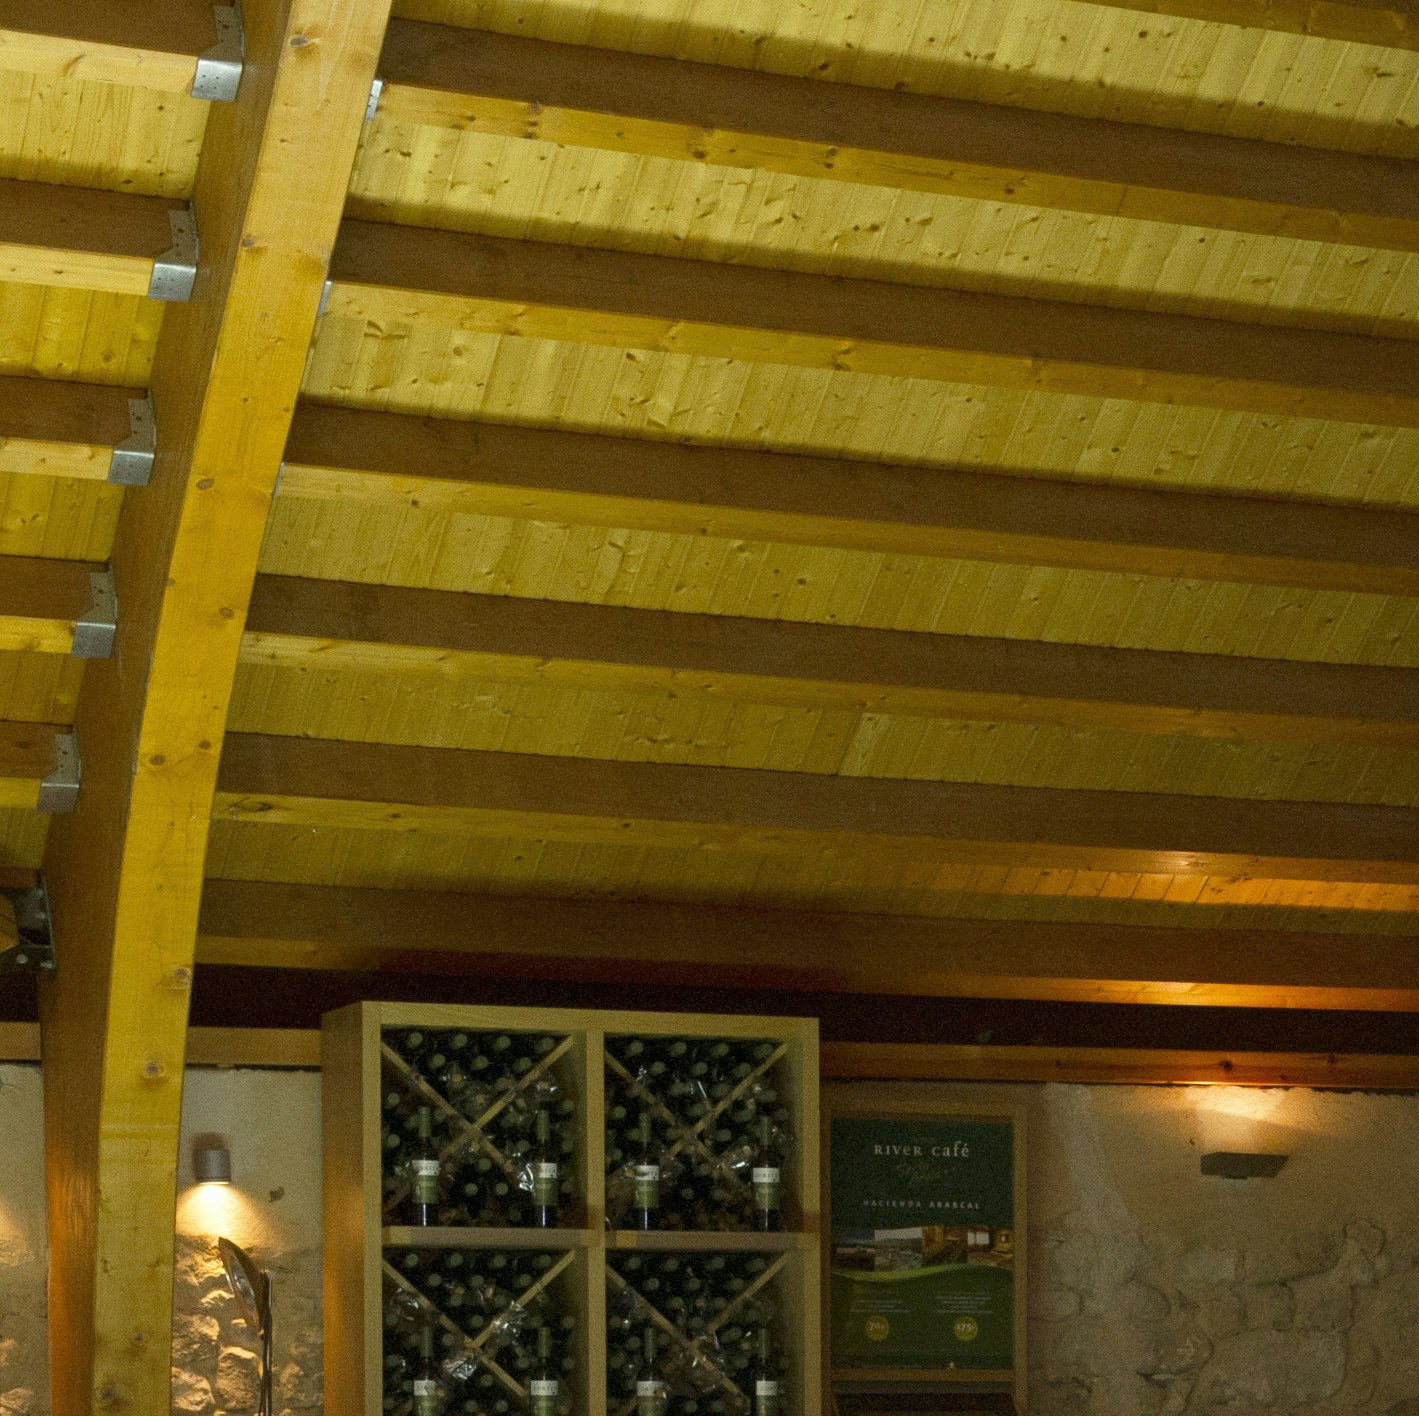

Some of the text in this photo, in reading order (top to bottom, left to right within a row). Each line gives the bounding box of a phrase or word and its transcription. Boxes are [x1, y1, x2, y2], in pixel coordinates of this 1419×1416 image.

[931, 1140, 971, 1158] café
[862, 1199, 981, 1210] HACIENDA ABASCAL
